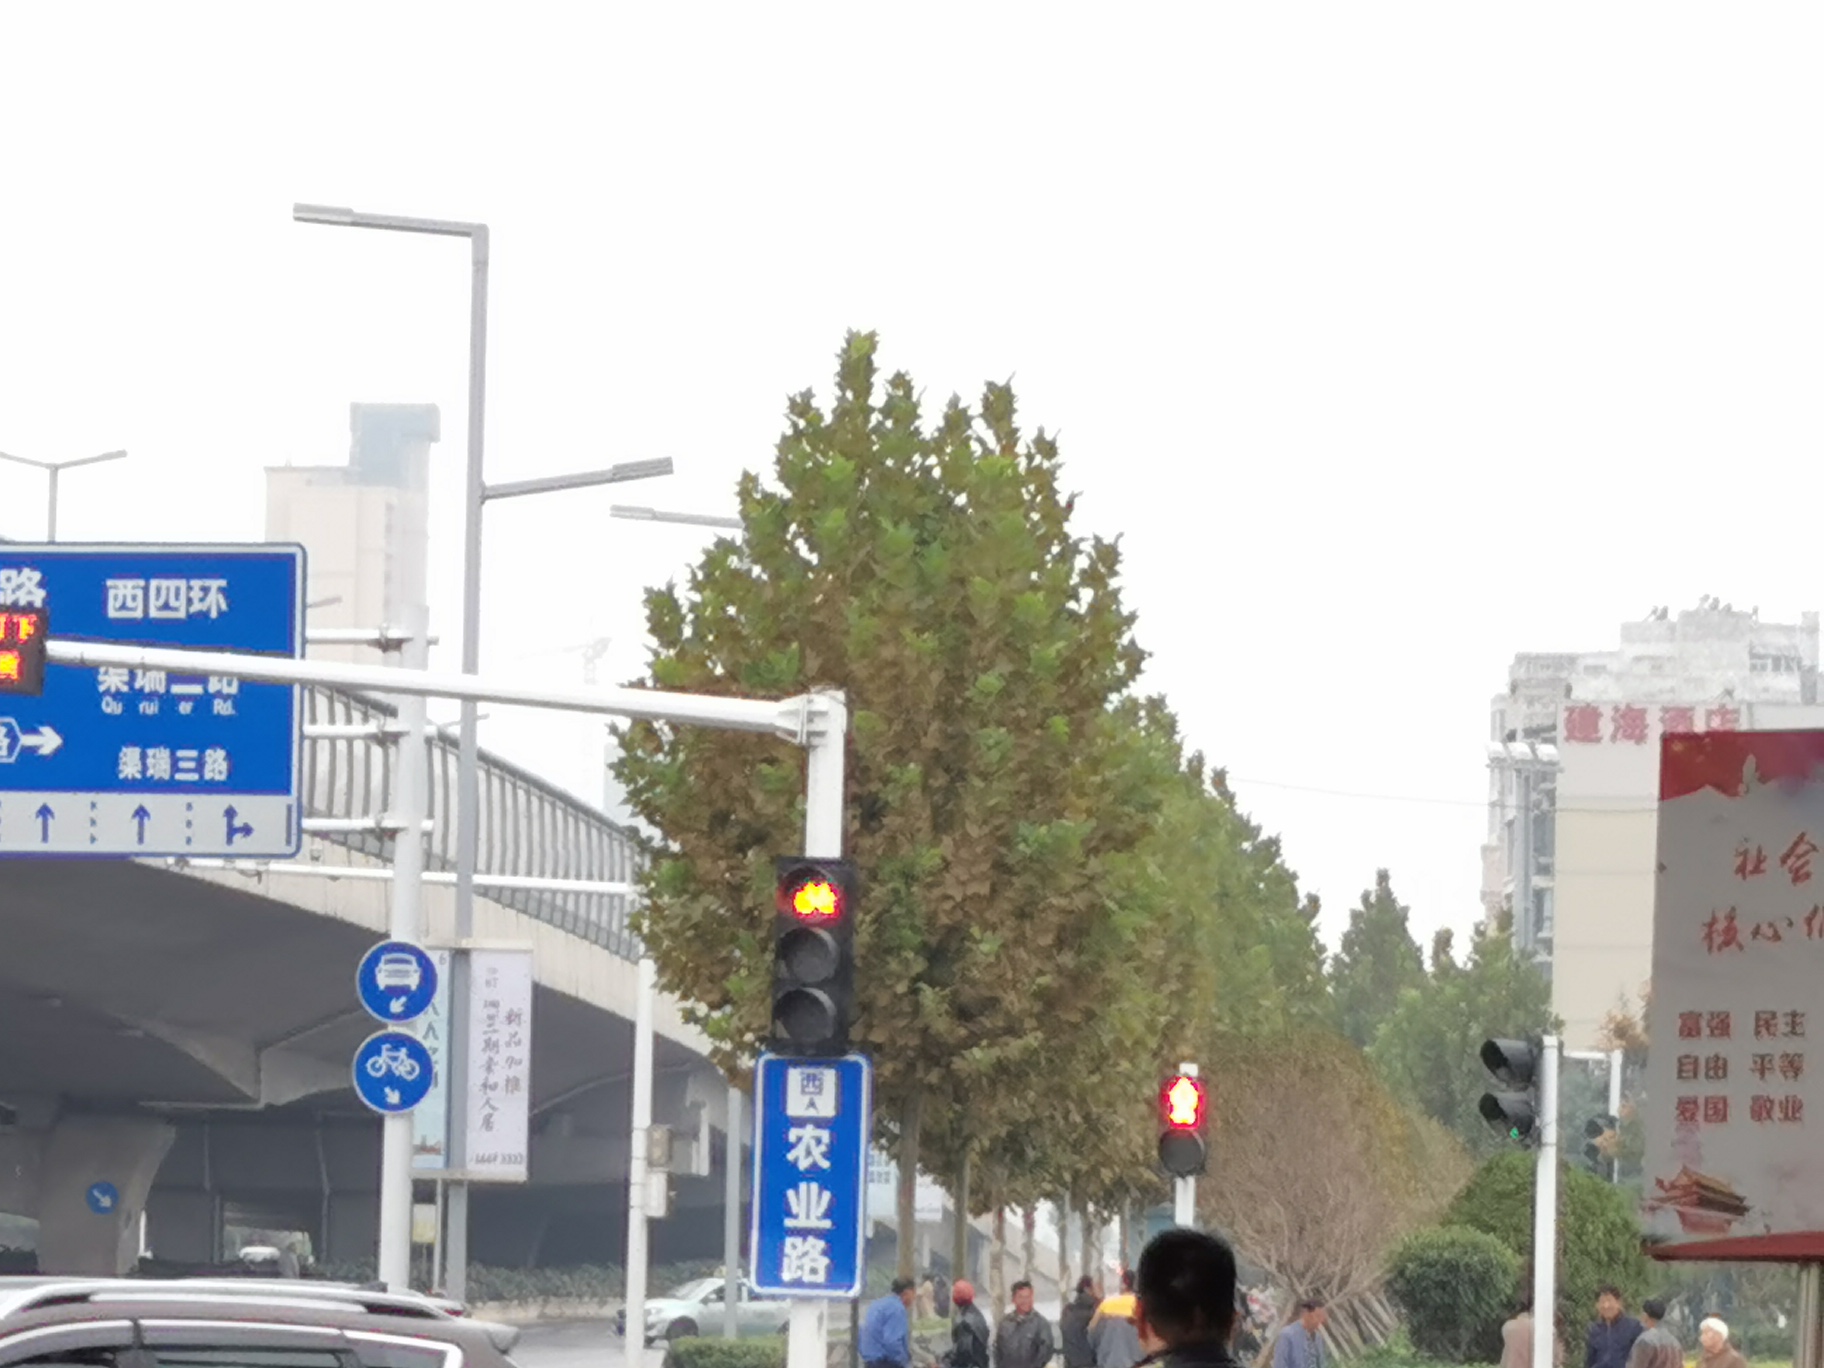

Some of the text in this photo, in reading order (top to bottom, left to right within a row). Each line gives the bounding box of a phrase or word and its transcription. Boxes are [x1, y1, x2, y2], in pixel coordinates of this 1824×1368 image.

[106, 578, 228, 619] 西四环
[118, 747, 229, 781] 渠瑞三路
[1733, 831, 1819, 886] 社会
[1677, 1051, 1804, 1082] 自由 平等
[781, 1123, 833, 1283] 农业路
